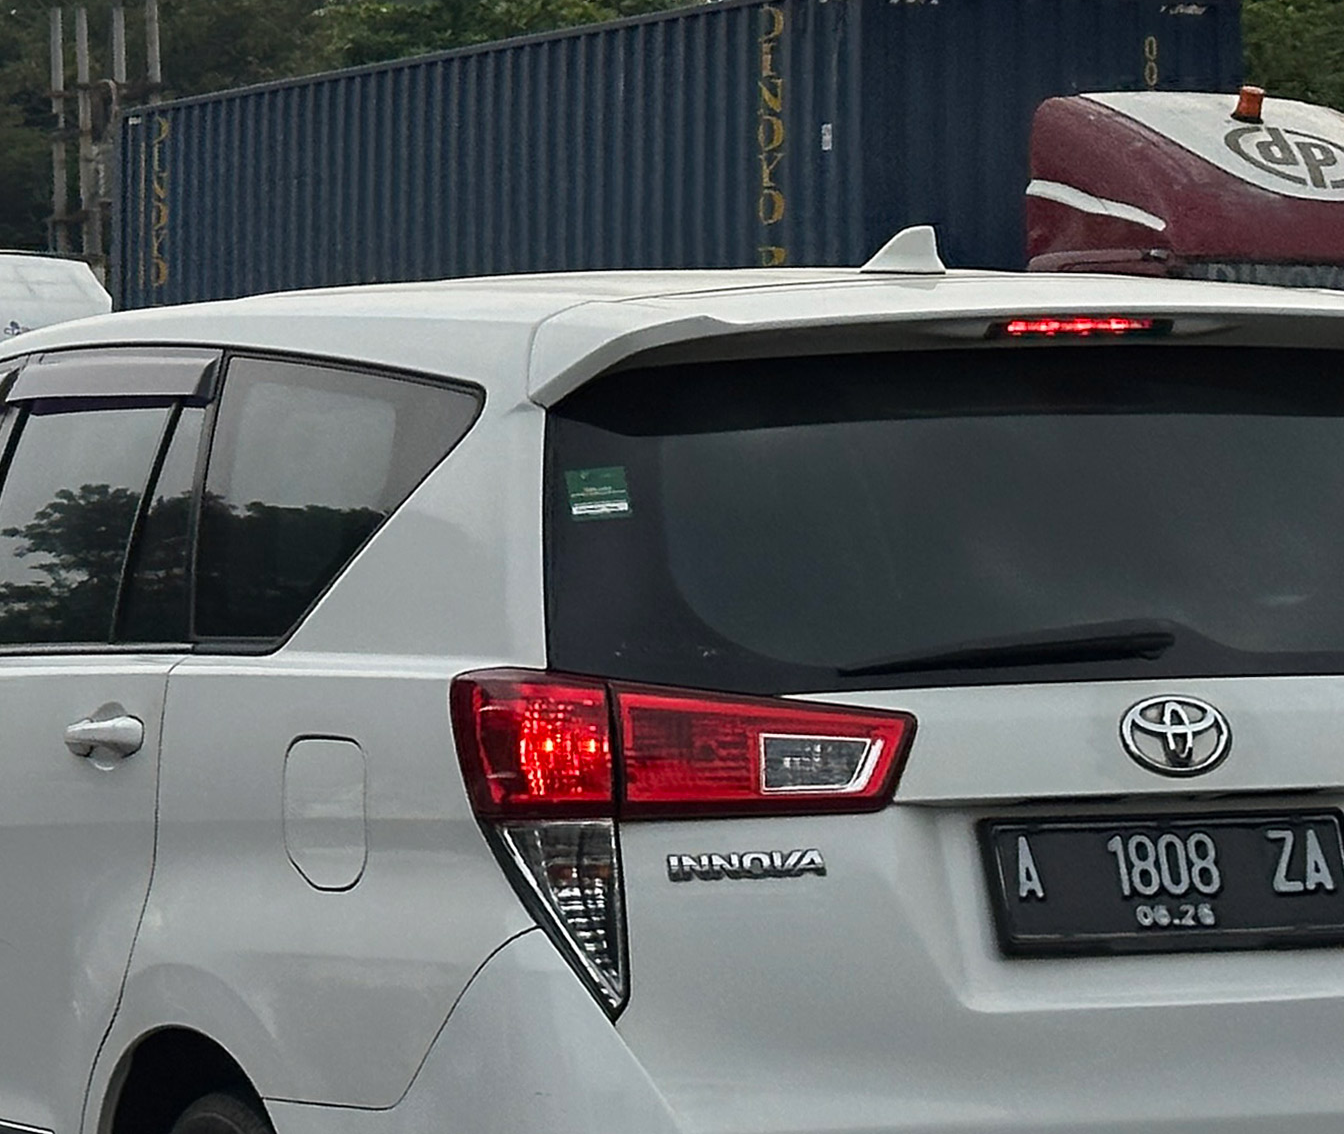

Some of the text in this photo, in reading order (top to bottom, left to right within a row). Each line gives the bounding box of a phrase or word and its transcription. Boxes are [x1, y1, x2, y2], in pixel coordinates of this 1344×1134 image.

[667, 848, 827, 883] INNOVA
[1017, 828, 1336, 898] A 1808 ZA
